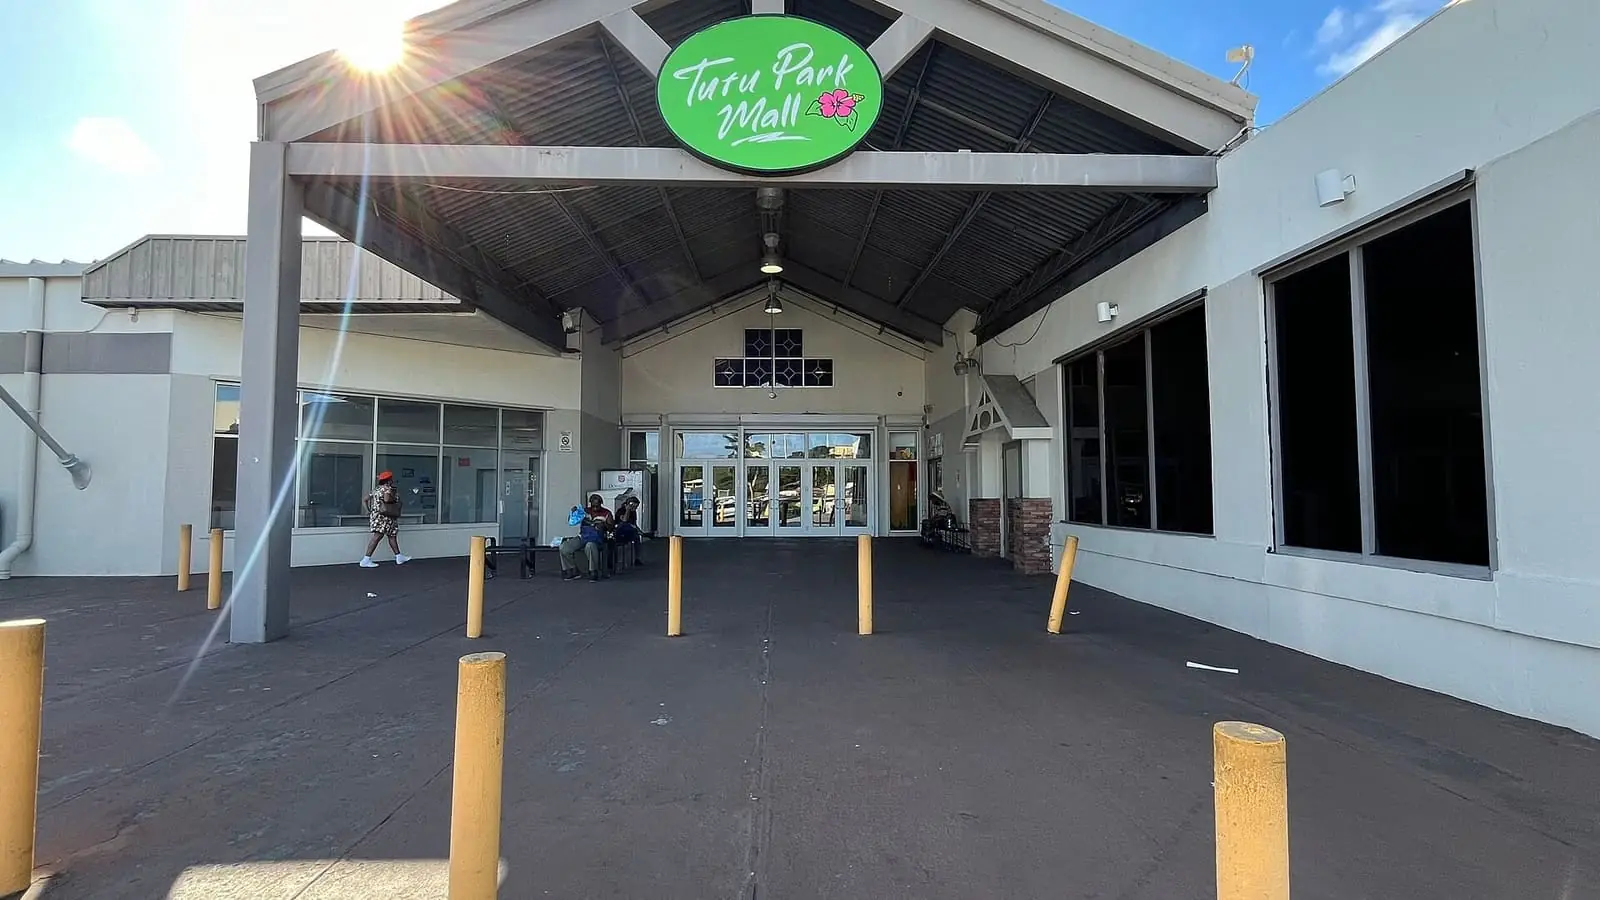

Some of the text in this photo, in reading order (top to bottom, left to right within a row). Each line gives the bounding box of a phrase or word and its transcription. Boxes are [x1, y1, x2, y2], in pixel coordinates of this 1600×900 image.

[673, 43, 854, 107] Tutu Park
[717, 93, 801, 140] Mall
